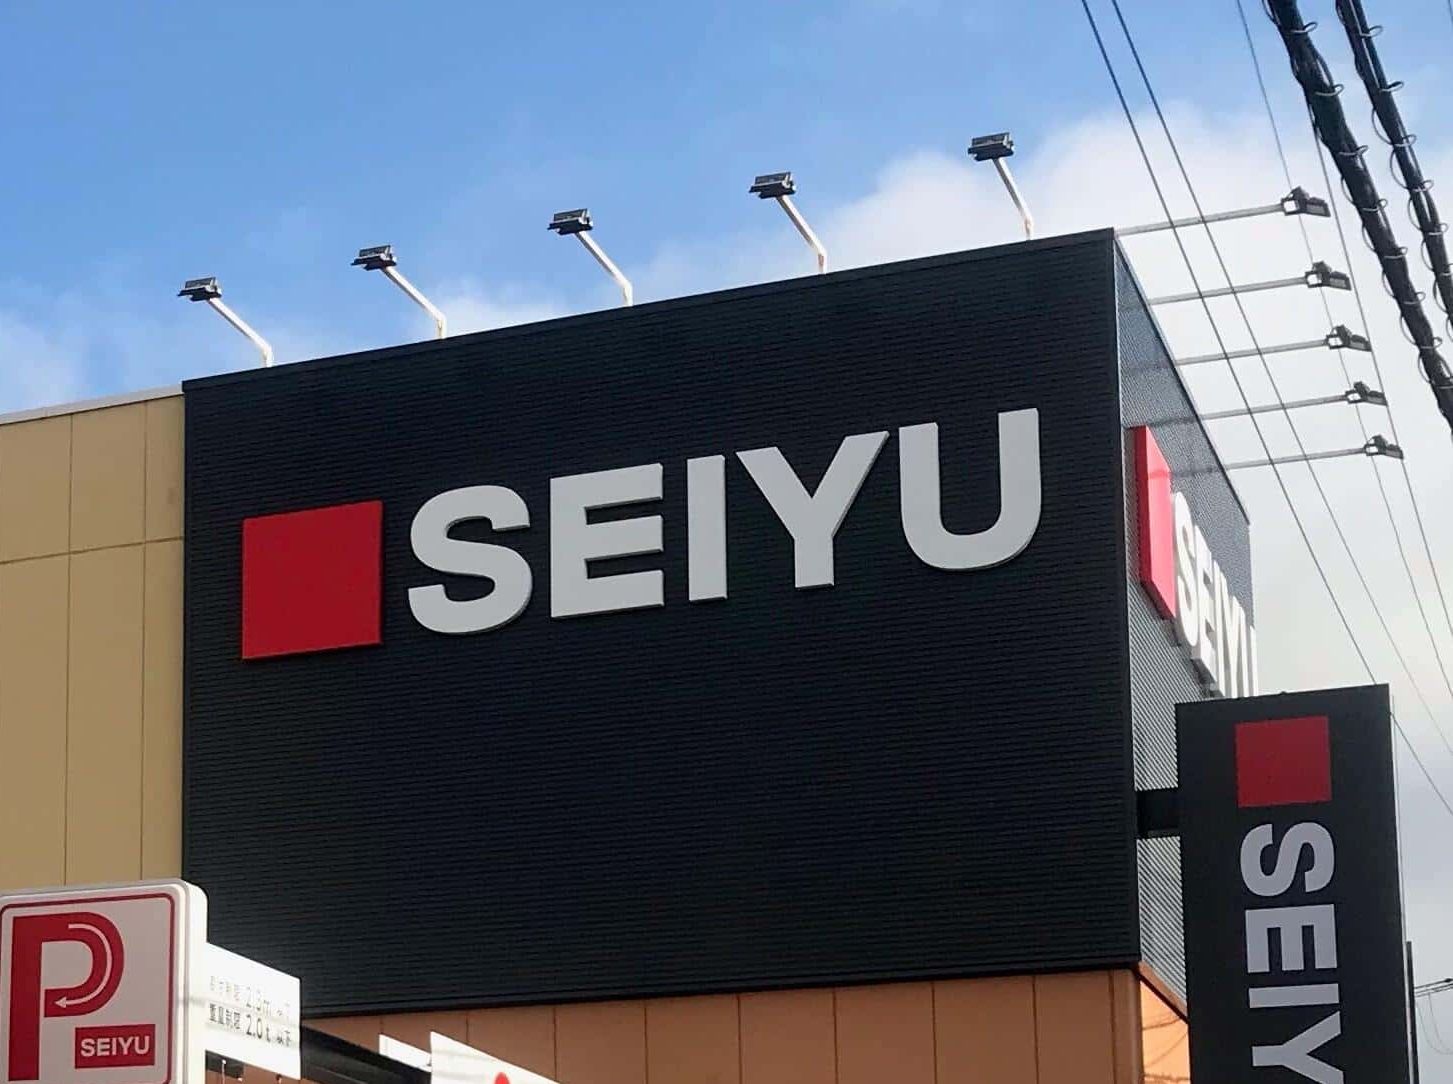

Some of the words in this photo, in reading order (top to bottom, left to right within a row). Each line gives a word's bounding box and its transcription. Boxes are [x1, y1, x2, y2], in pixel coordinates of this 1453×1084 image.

[408, 408, 1043, 634] SEIYU
[7, 912, 124, 1081] P
[80, 1036, 151, 1058] SEIYU
